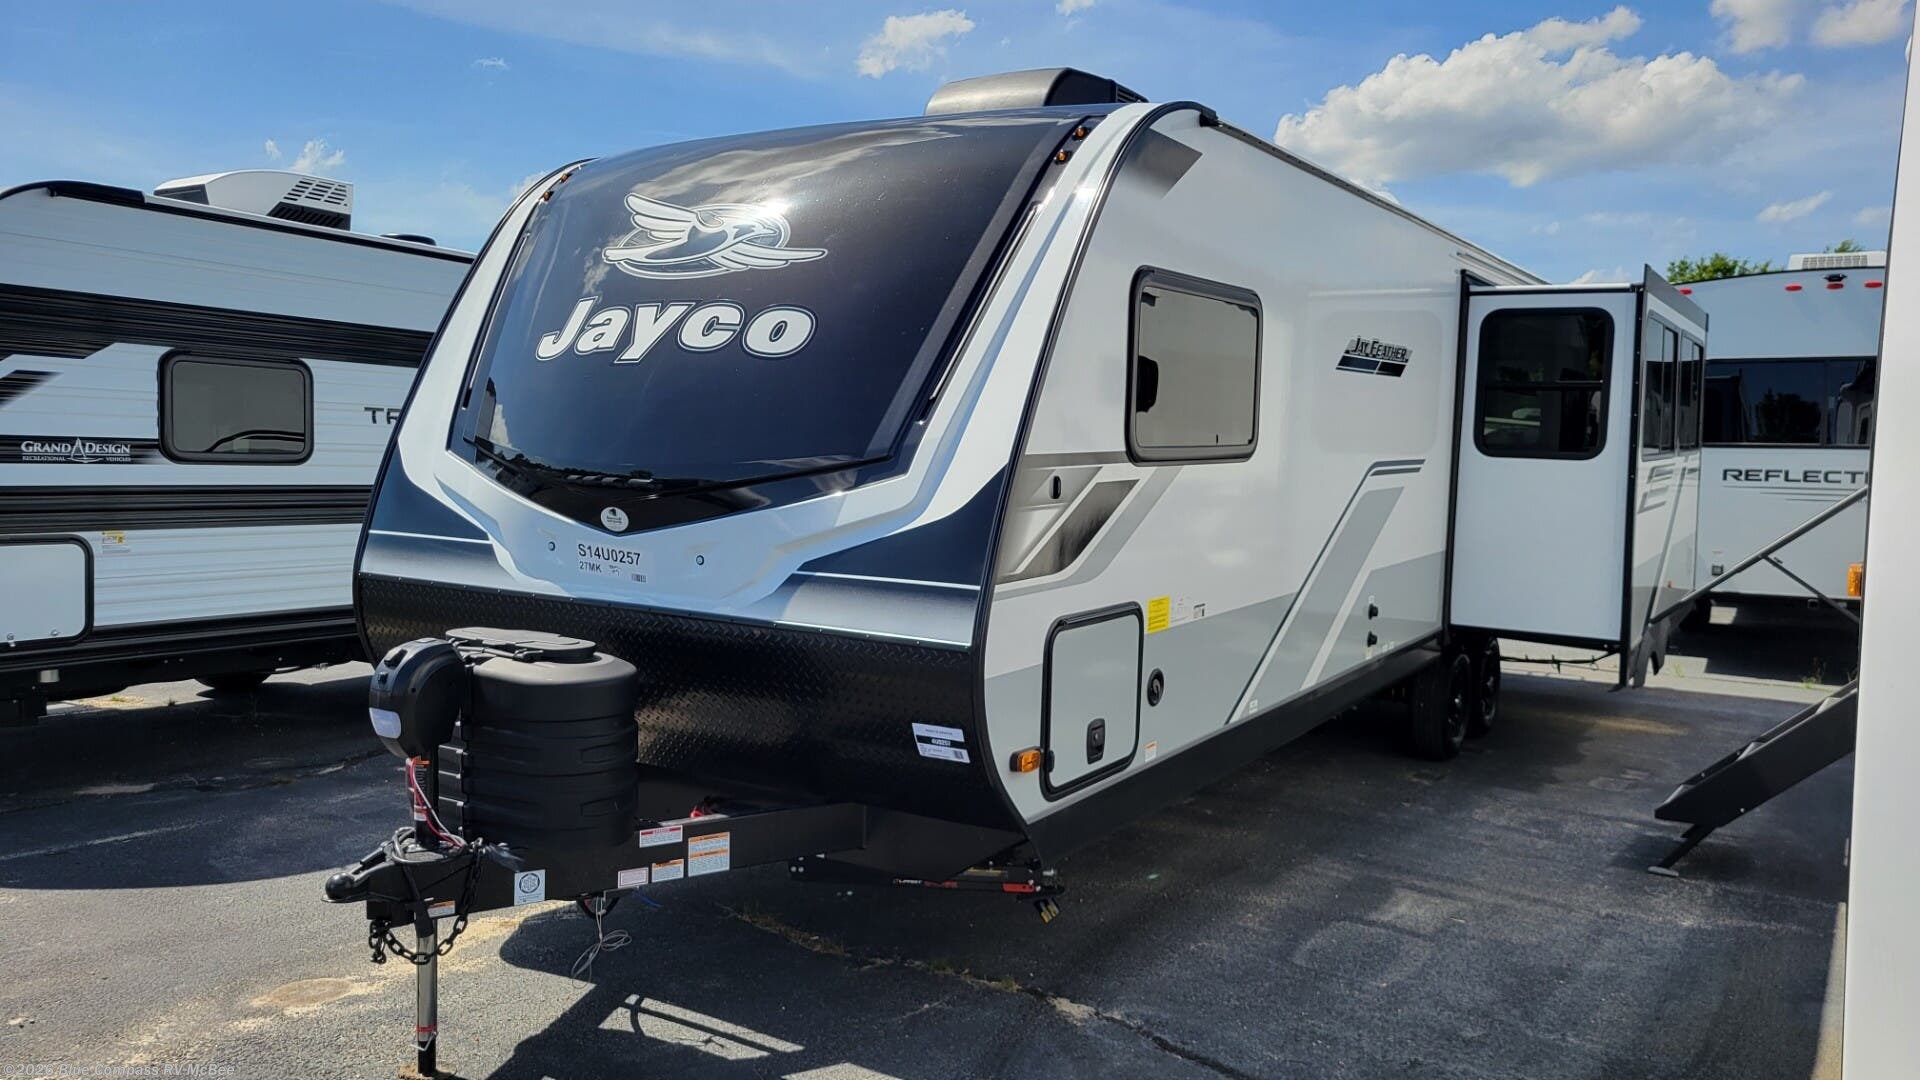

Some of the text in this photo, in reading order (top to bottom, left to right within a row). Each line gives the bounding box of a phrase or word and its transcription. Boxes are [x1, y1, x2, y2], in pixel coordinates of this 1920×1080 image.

[535, 296, 817, 364] Jayco
[21, 440, 131, 455] GRAND DESIGN
[578, 543, 641, 566] S14U0257
